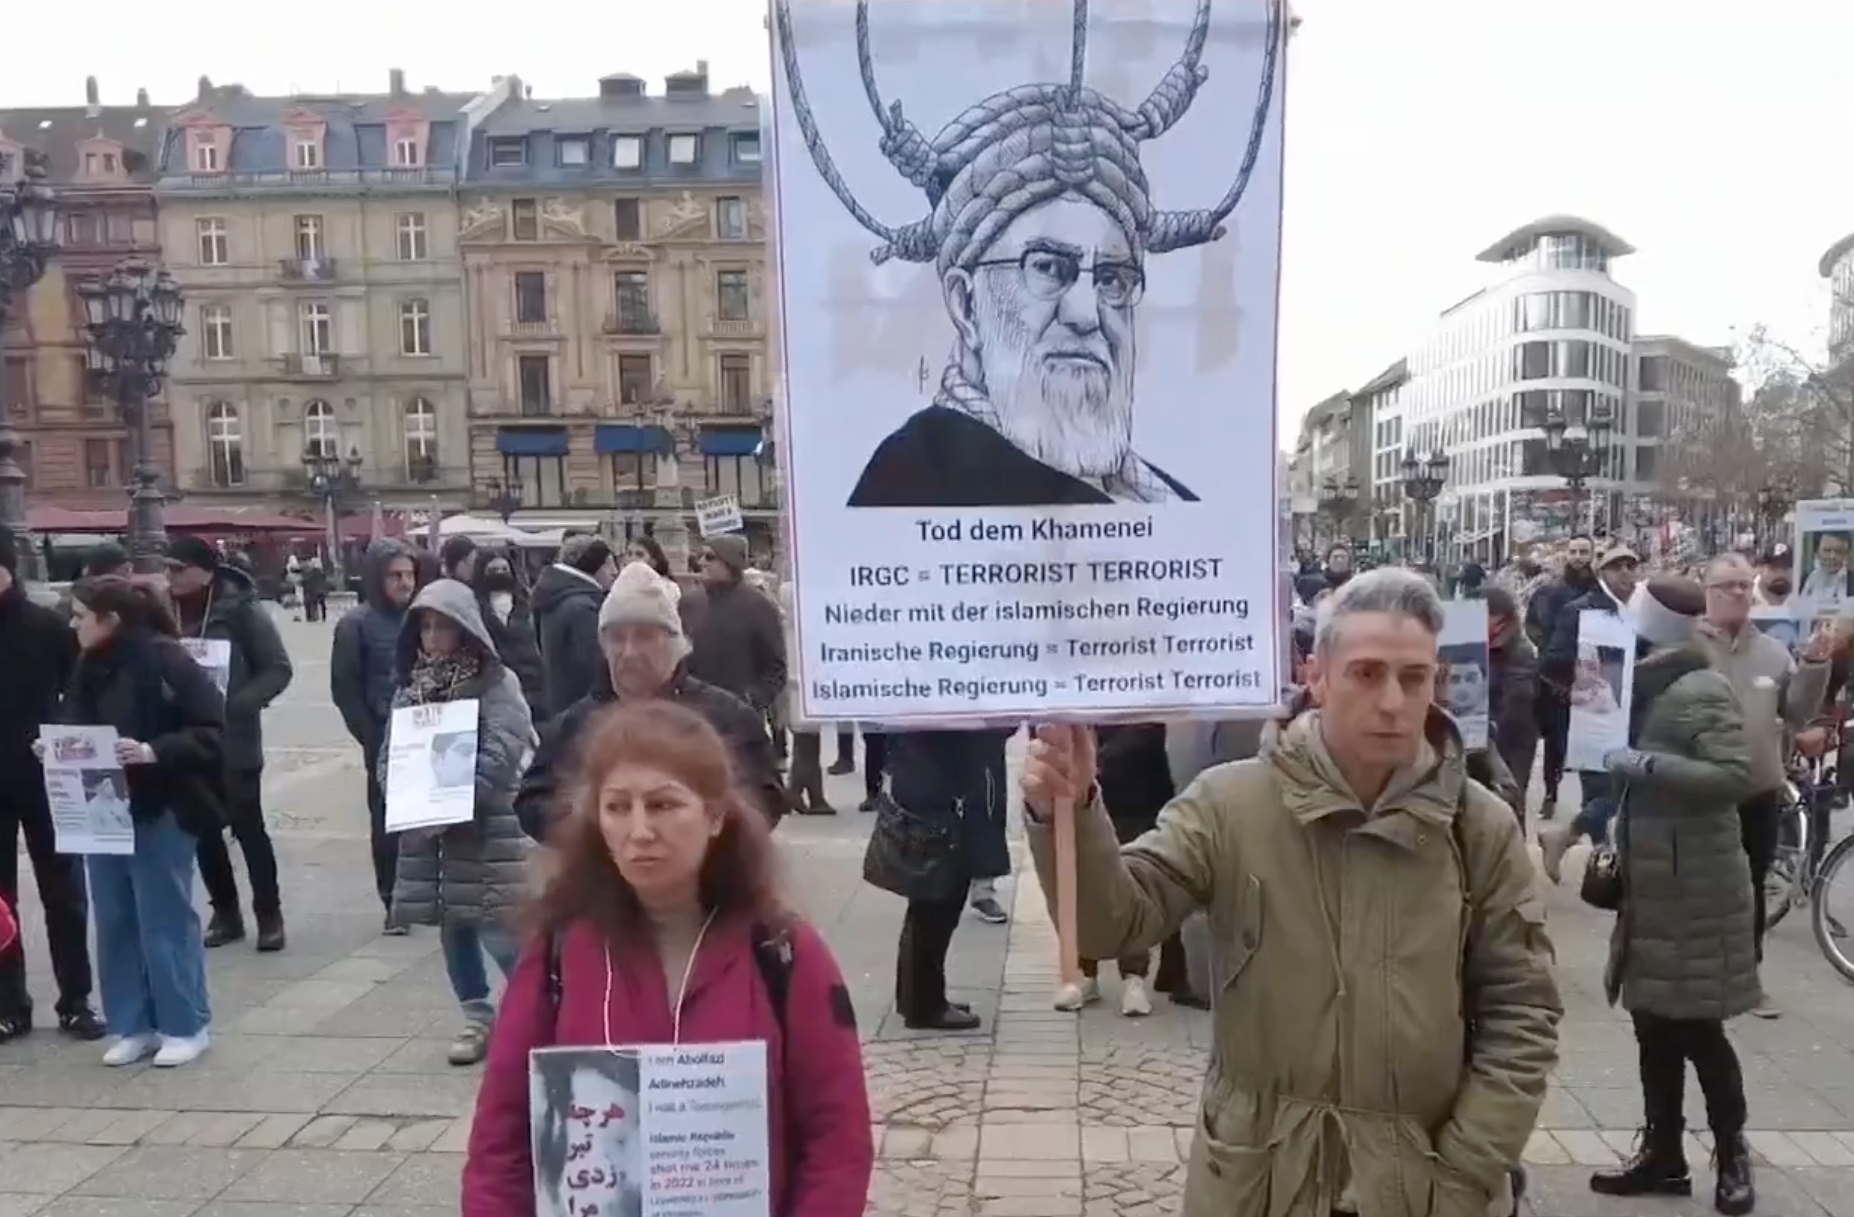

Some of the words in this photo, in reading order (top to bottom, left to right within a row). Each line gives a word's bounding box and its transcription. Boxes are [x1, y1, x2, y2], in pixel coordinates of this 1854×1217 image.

[915, 518, 962, 542] Tod
[969, 518, 1024, 542] dem
[1031, 515, 1153, 541] Khamenei
[850, 564, 910, 587] IRGC
[917, 569, 931, 583] =
[938, 561, 1079, 586] TERRORIST
[1085, 557, 1224, 583] TERRORIST
[824, 601, 903, 624] Nieder
[908, 601, 946, 623] mit
[951, 600, 989, 622] der
[995, 597, 1130, 620] islamischen
[1136, 596, 1249, 622] Regierung
[820, 641, 923, 662] Iranische
[928, 640, 1040, 665] Regierung
[1045, 643, 1059, 655] =
[1066, 636, 1157, 657] Terrorist
[1162, 633, 1254, 655] Terrorist
[812, 677, 932, 700] Islamische
[937, 676, 1048, 701] Regierung
[1073, 673, 1165, 694] Terrorist
[1171, 669, 1261, 690] Terrorist
